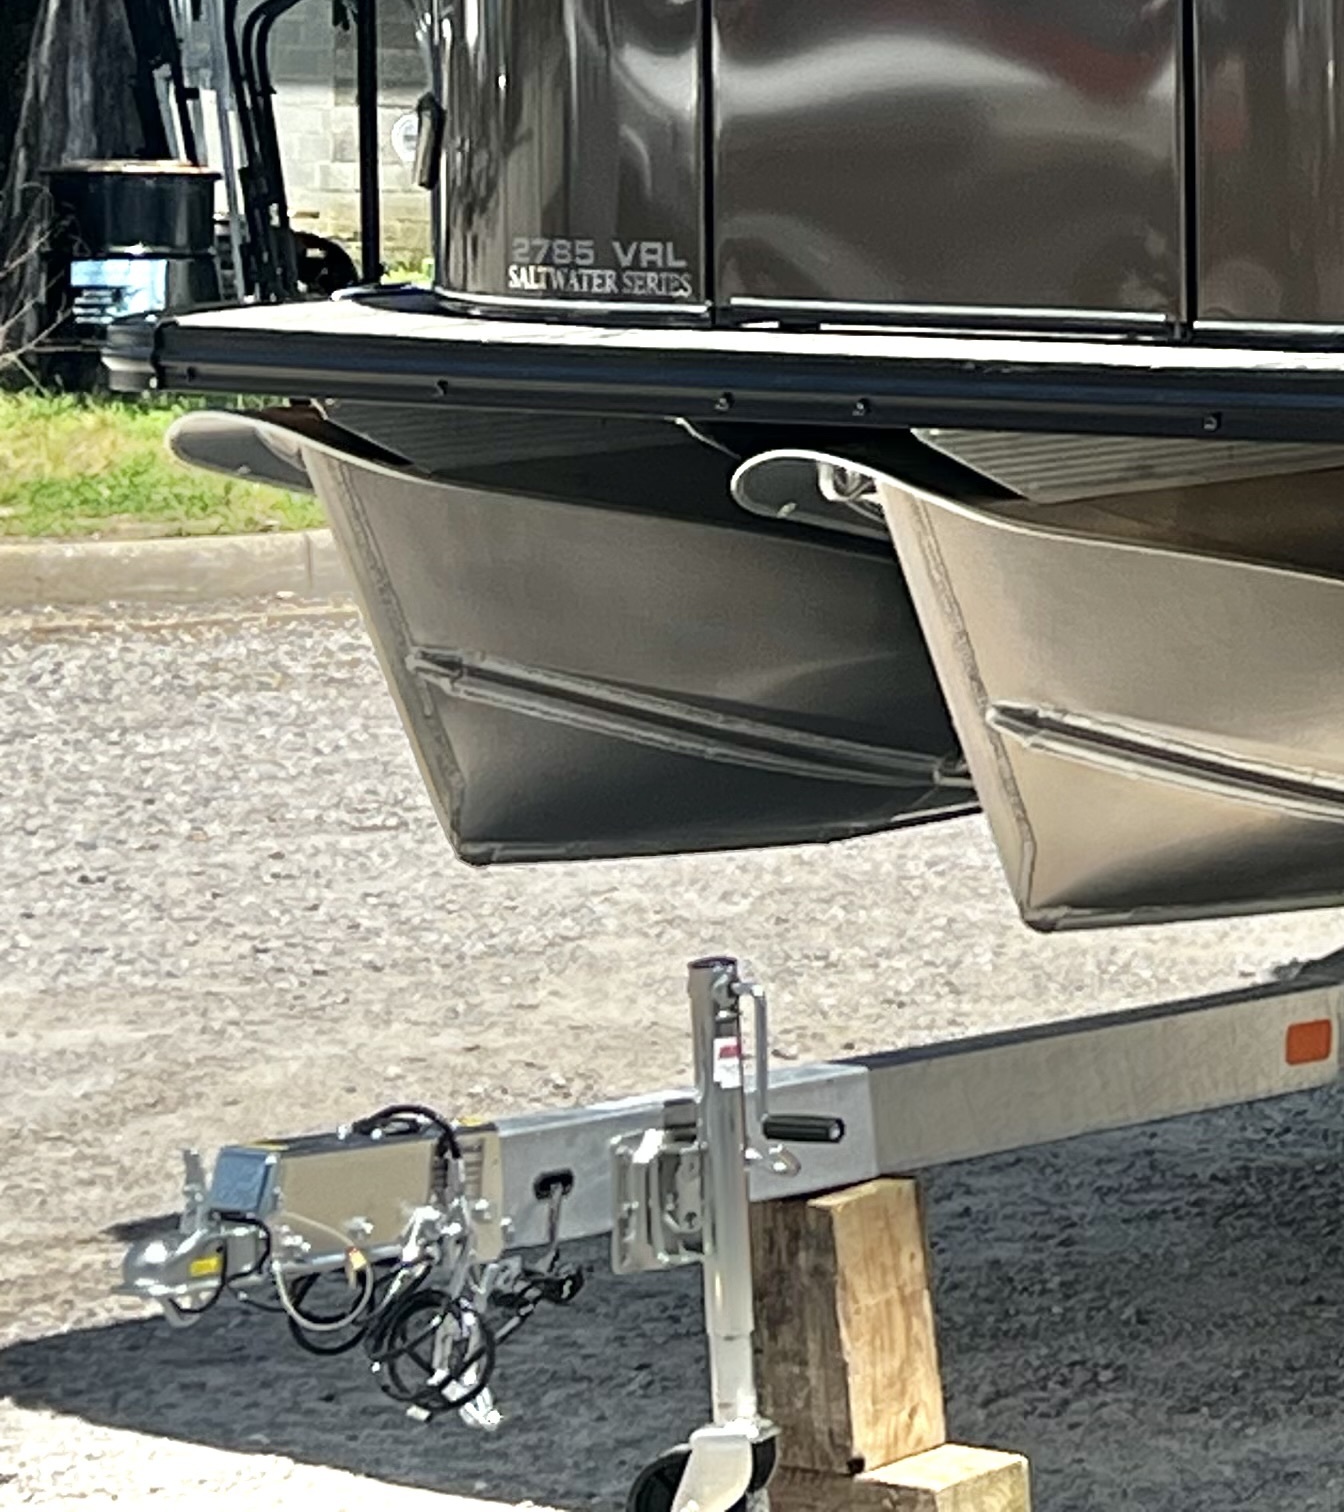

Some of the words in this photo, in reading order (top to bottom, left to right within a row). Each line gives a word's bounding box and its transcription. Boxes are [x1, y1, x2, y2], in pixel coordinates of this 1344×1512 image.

[511, 238, 594, 265] 2785
[508, 264, 619, 294] SALTWATER
[622, 272, 693, 299] SERIES
